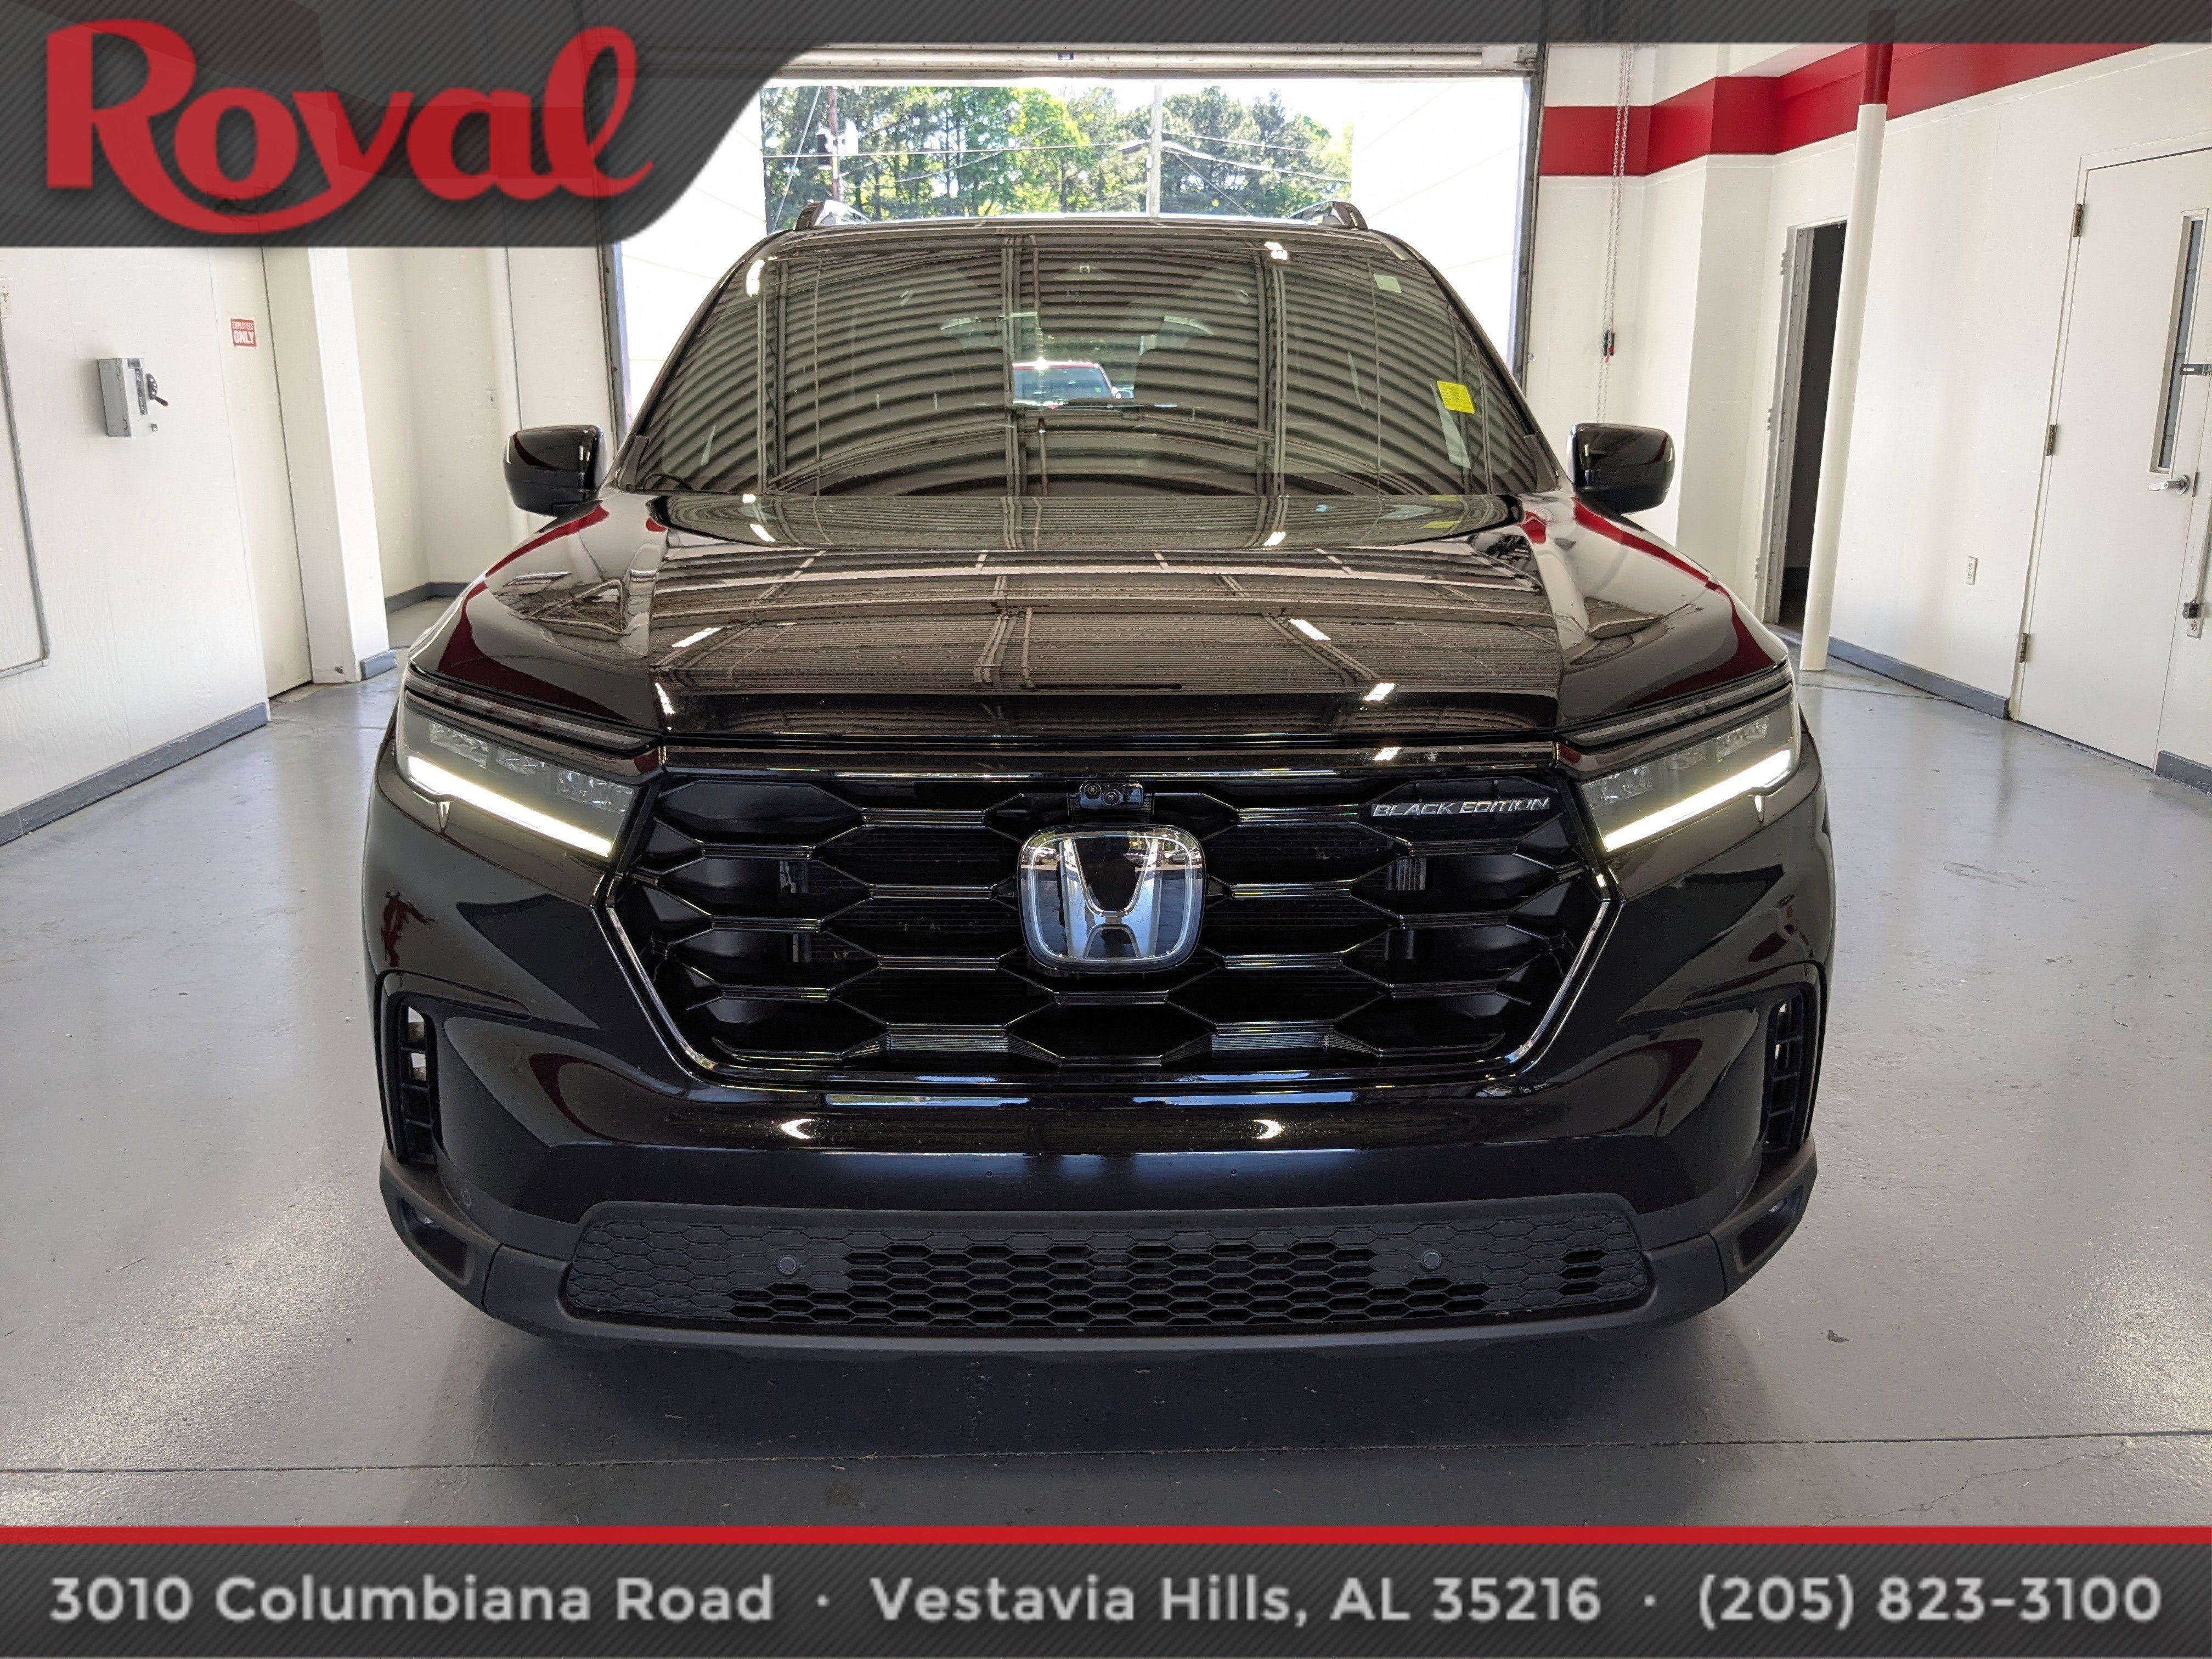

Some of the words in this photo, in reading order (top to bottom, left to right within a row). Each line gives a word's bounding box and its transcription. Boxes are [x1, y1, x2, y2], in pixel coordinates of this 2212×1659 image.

[233, 330, 255, 345] ONLY
[1373, 802, 1457, 816] BLACK
[1459, 798, 1550, 814] EDITION
